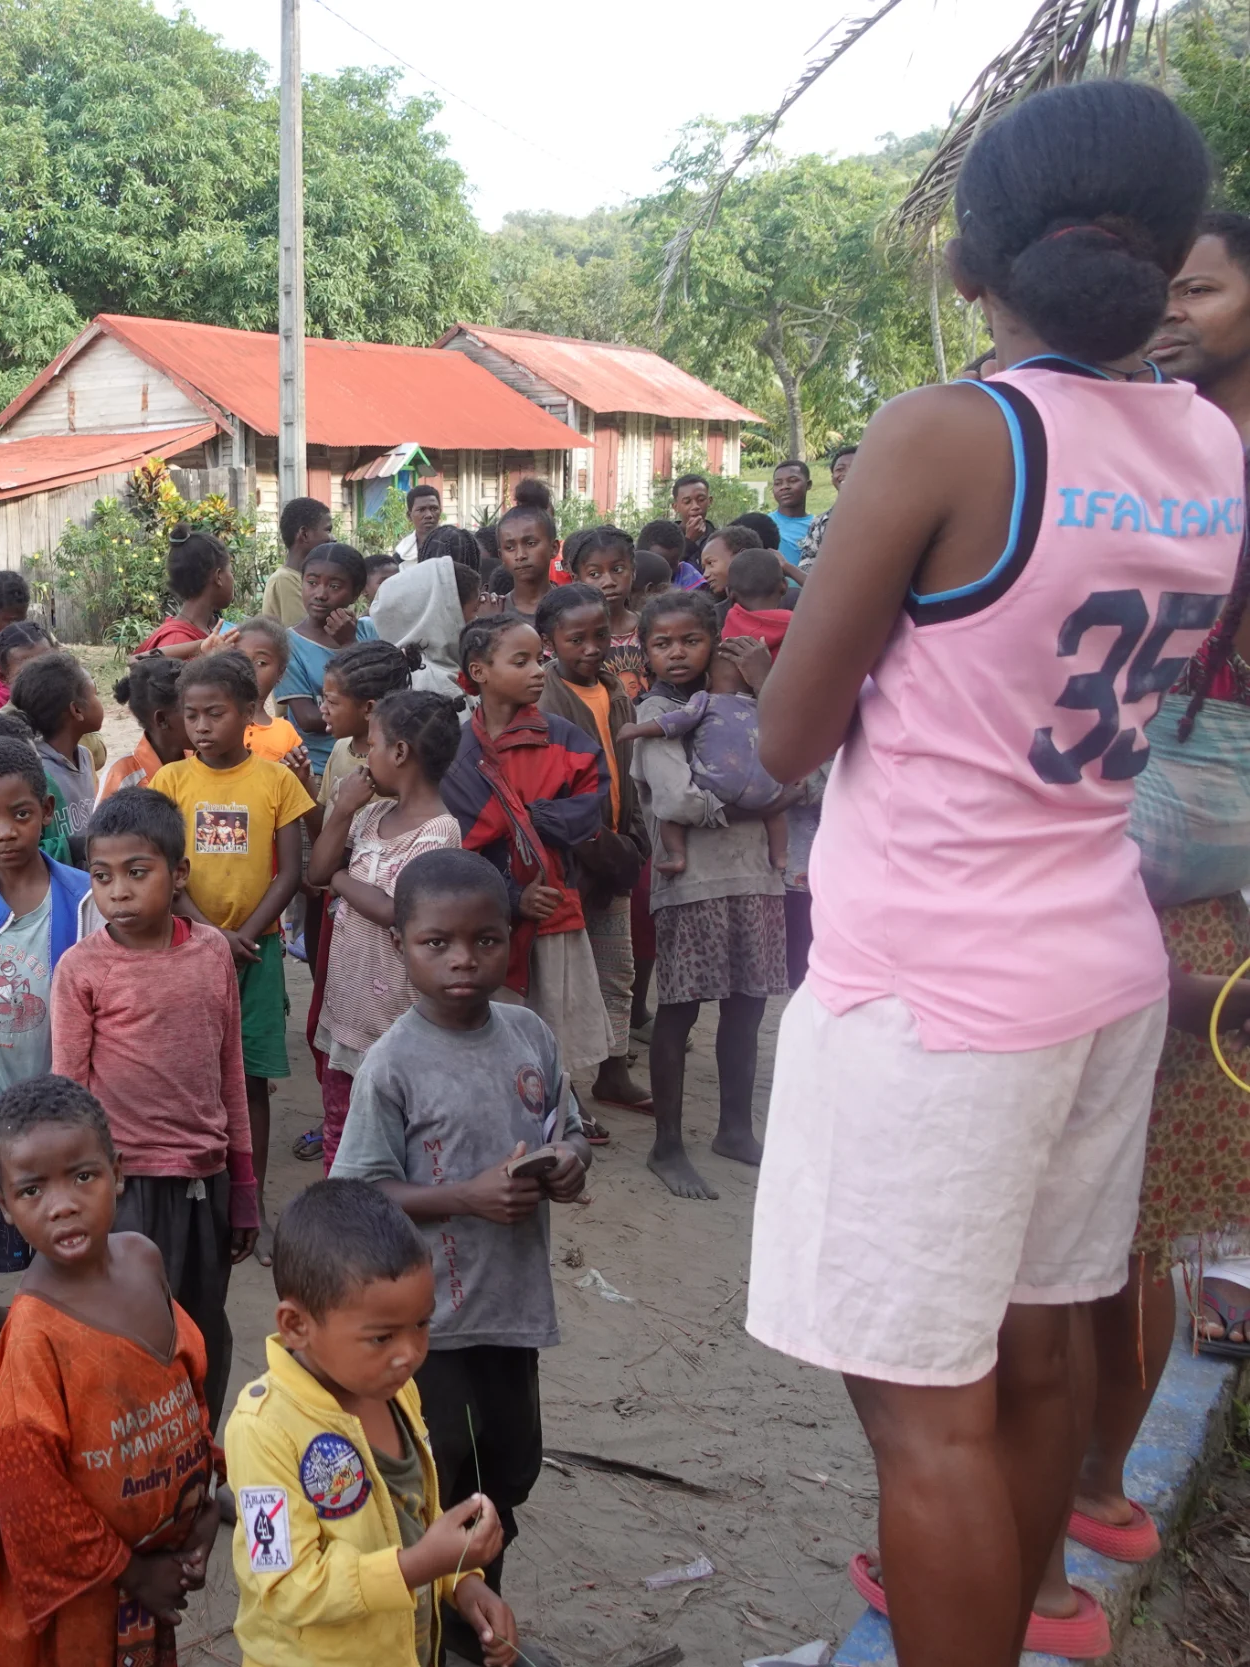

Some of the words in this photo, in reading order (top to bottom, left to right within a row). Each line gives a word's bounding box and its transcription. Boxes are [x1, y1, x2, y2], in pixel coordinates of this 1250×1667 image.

[1027, 588, 1231, 784] 35
[423, 1139, 452, 1224] Mieza
[440, 1232, 465, 1312] hatrany
[81, 1446, 113, 1470] TSY
[120, 1413, 185, 1463] MAINTSY
[122, 1466, 172, 1498] Andry
[257, 1516, 272, 1540] 41
